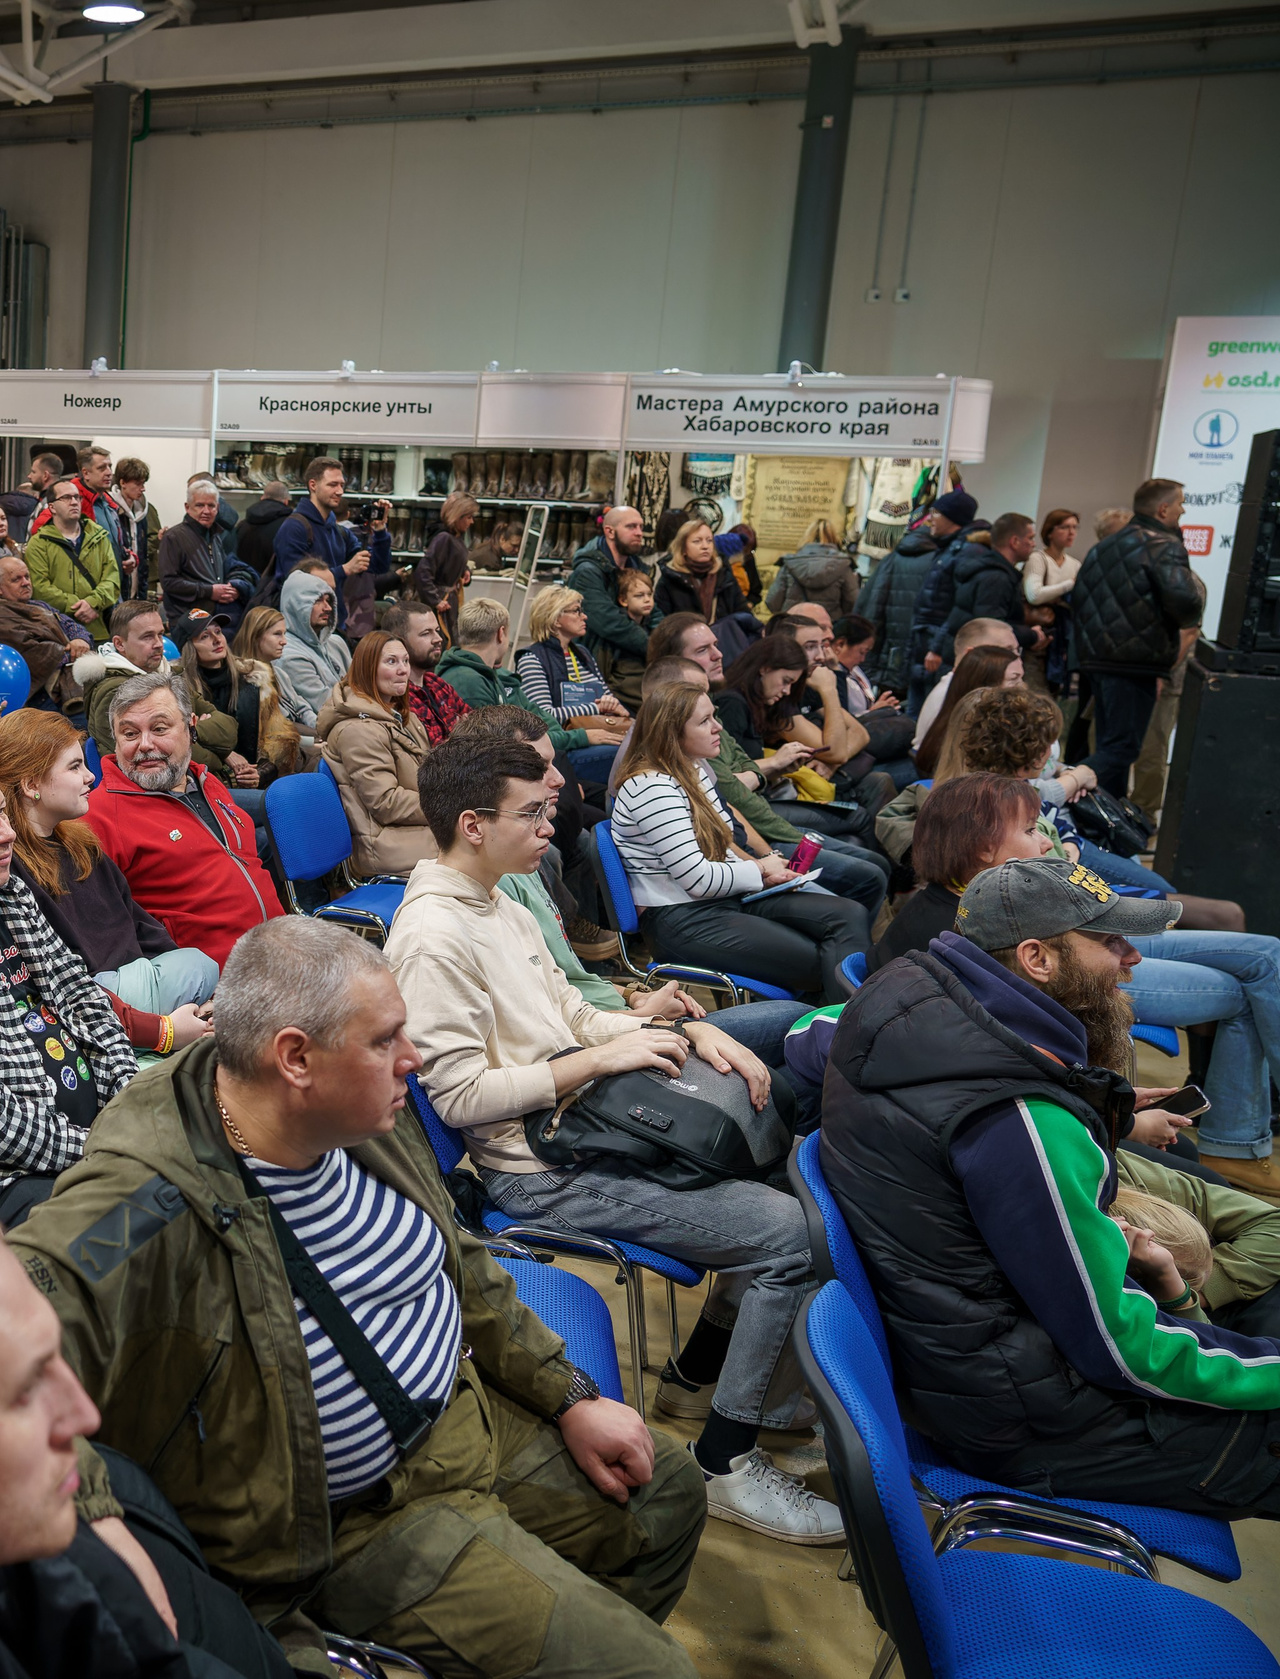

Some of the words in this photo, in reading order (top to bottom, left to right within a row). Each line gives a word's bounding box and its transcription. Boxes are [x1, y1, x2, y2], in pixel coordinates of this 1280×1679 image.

[1208, 341, 1280, 358] greenw
[63, 393, 122, 411] Ножеяр
[258, 396, 382, 415] Красноярские
[386, 401, 433, 417] унты
[636, 394, 724, 414] Мастера
[732, 395, 849, 416] Амурского
[858, 397, 940, 418] района
[682, 415, 832, 436] Хабаровского
[839, 420, 890, 439] края
